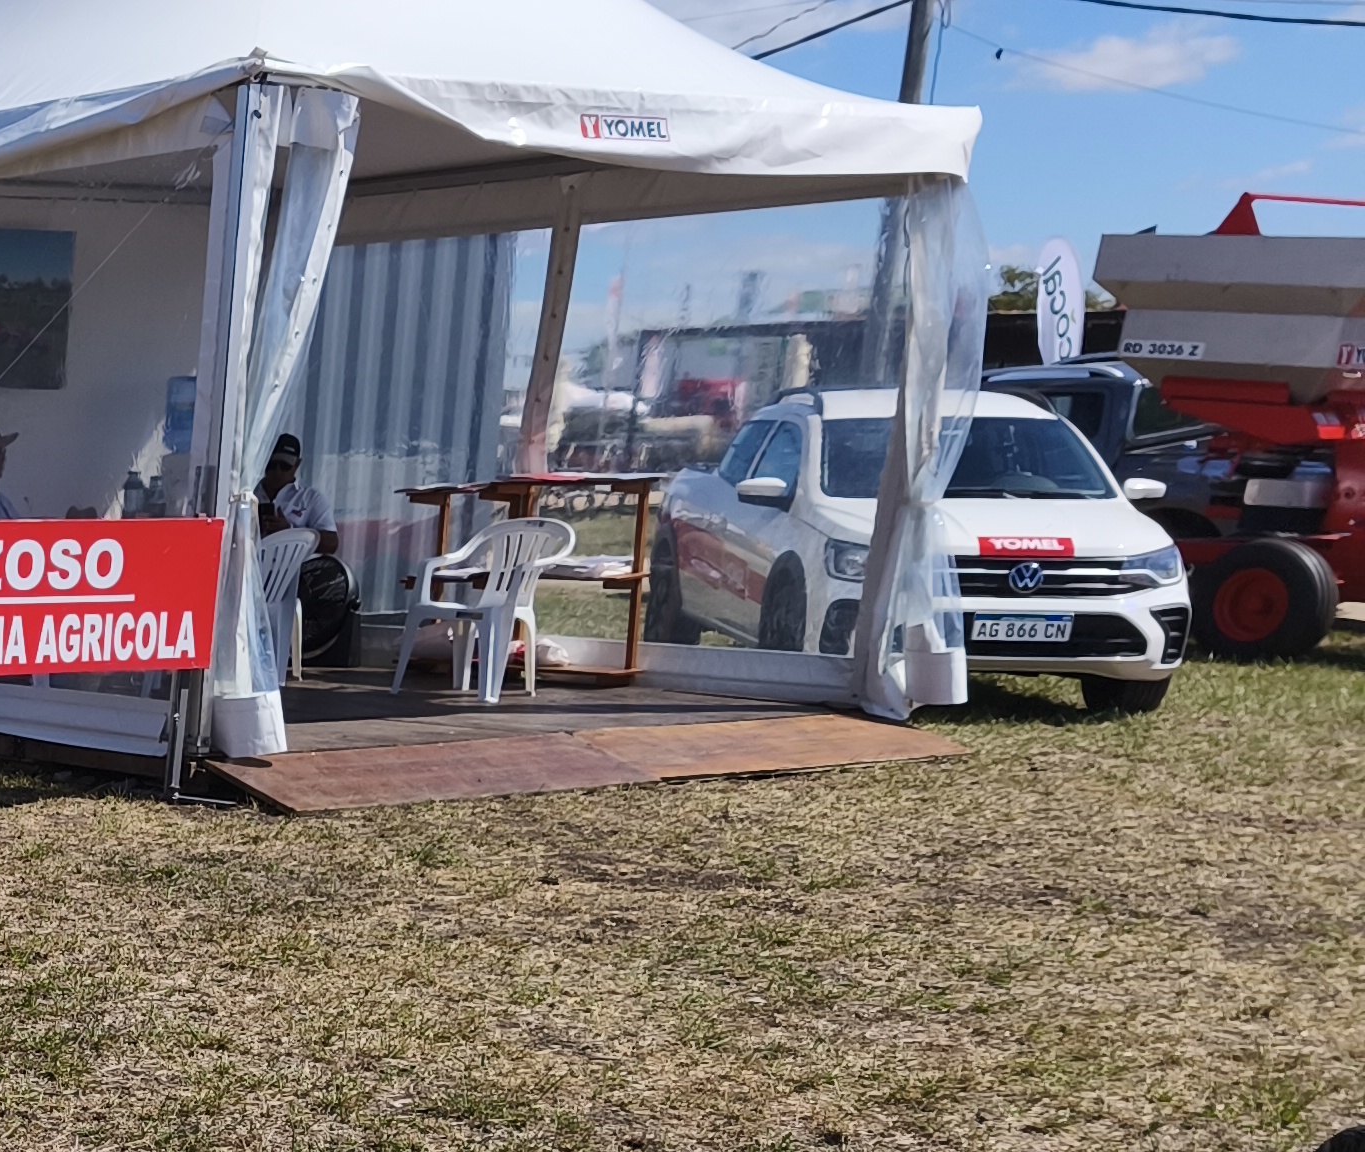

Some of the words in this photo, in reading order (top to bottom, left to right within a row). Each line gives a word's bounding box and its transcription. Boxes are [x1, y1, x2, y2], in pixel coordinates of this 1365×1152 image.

[602, 119, 666, 138] YOMEL
[1123, 342, 1143, 353] RD
[1188, 344, 1200, 356] Z
[988, 538, 1065, 551] YOMEL
[35, 611, 196, 664] AGRICOLA
[976, 622, 1000, 638] AG
[1005, 623, 1038, 639] 866
[1044, 623, 1067, 639] CN
